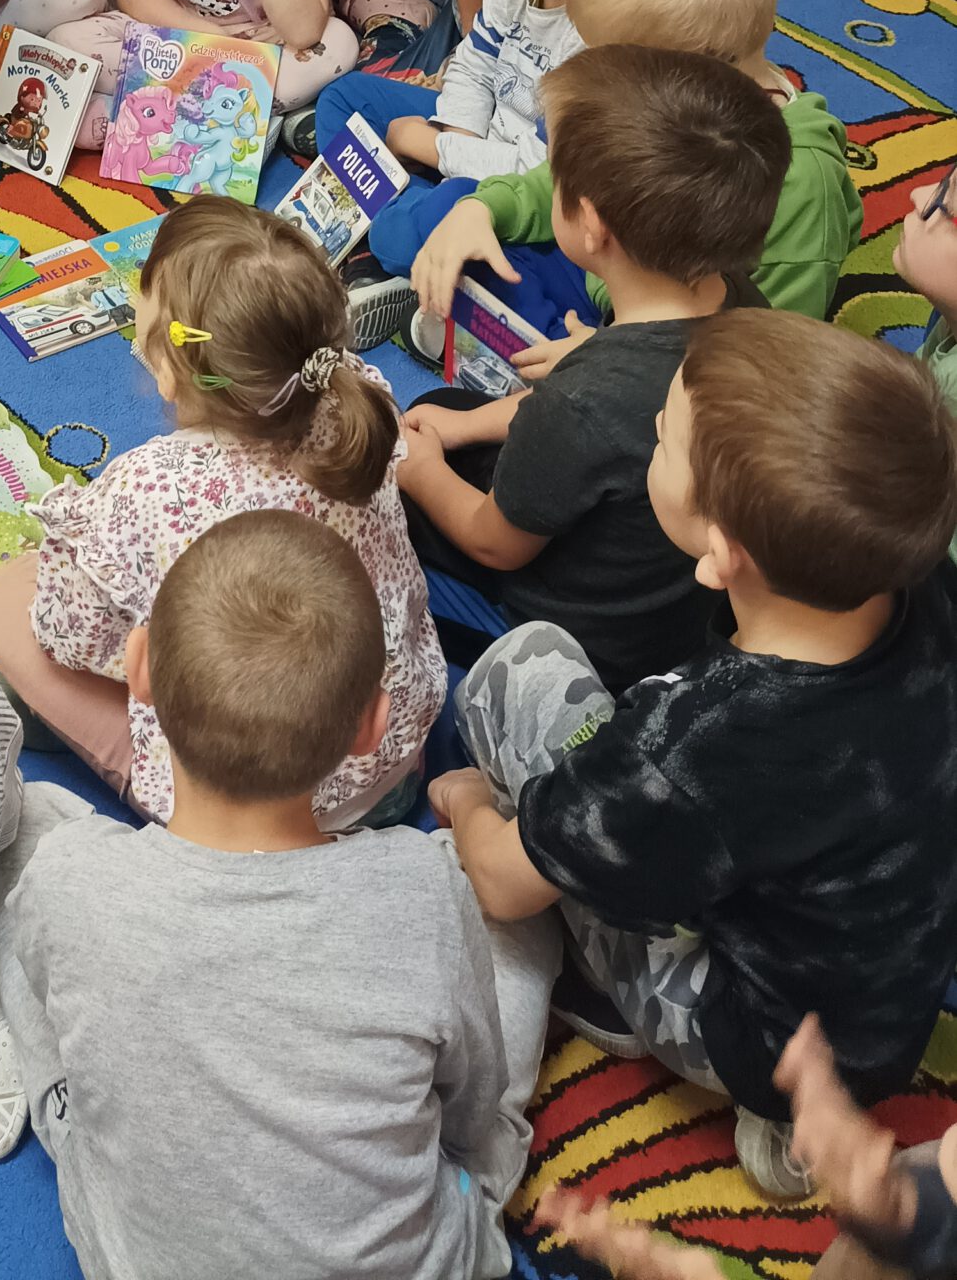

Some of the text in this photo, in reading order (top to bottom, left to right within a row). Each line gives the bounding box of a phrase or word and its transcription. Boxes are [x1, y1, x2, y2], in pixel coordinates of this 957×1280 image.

[145, 39, 157, 49] my
[155, 47, 178, 60] little
[190, 43, 216, 58] Gdzie
[41, 52, 70, 75] chłopiec
[143, 48, 178, 80] Pony
[7, 64, 71, 110] Motor Marka
[337, 144, 380, 200] POLICJA
[37, 258, 93, 285] MIEJSKA
